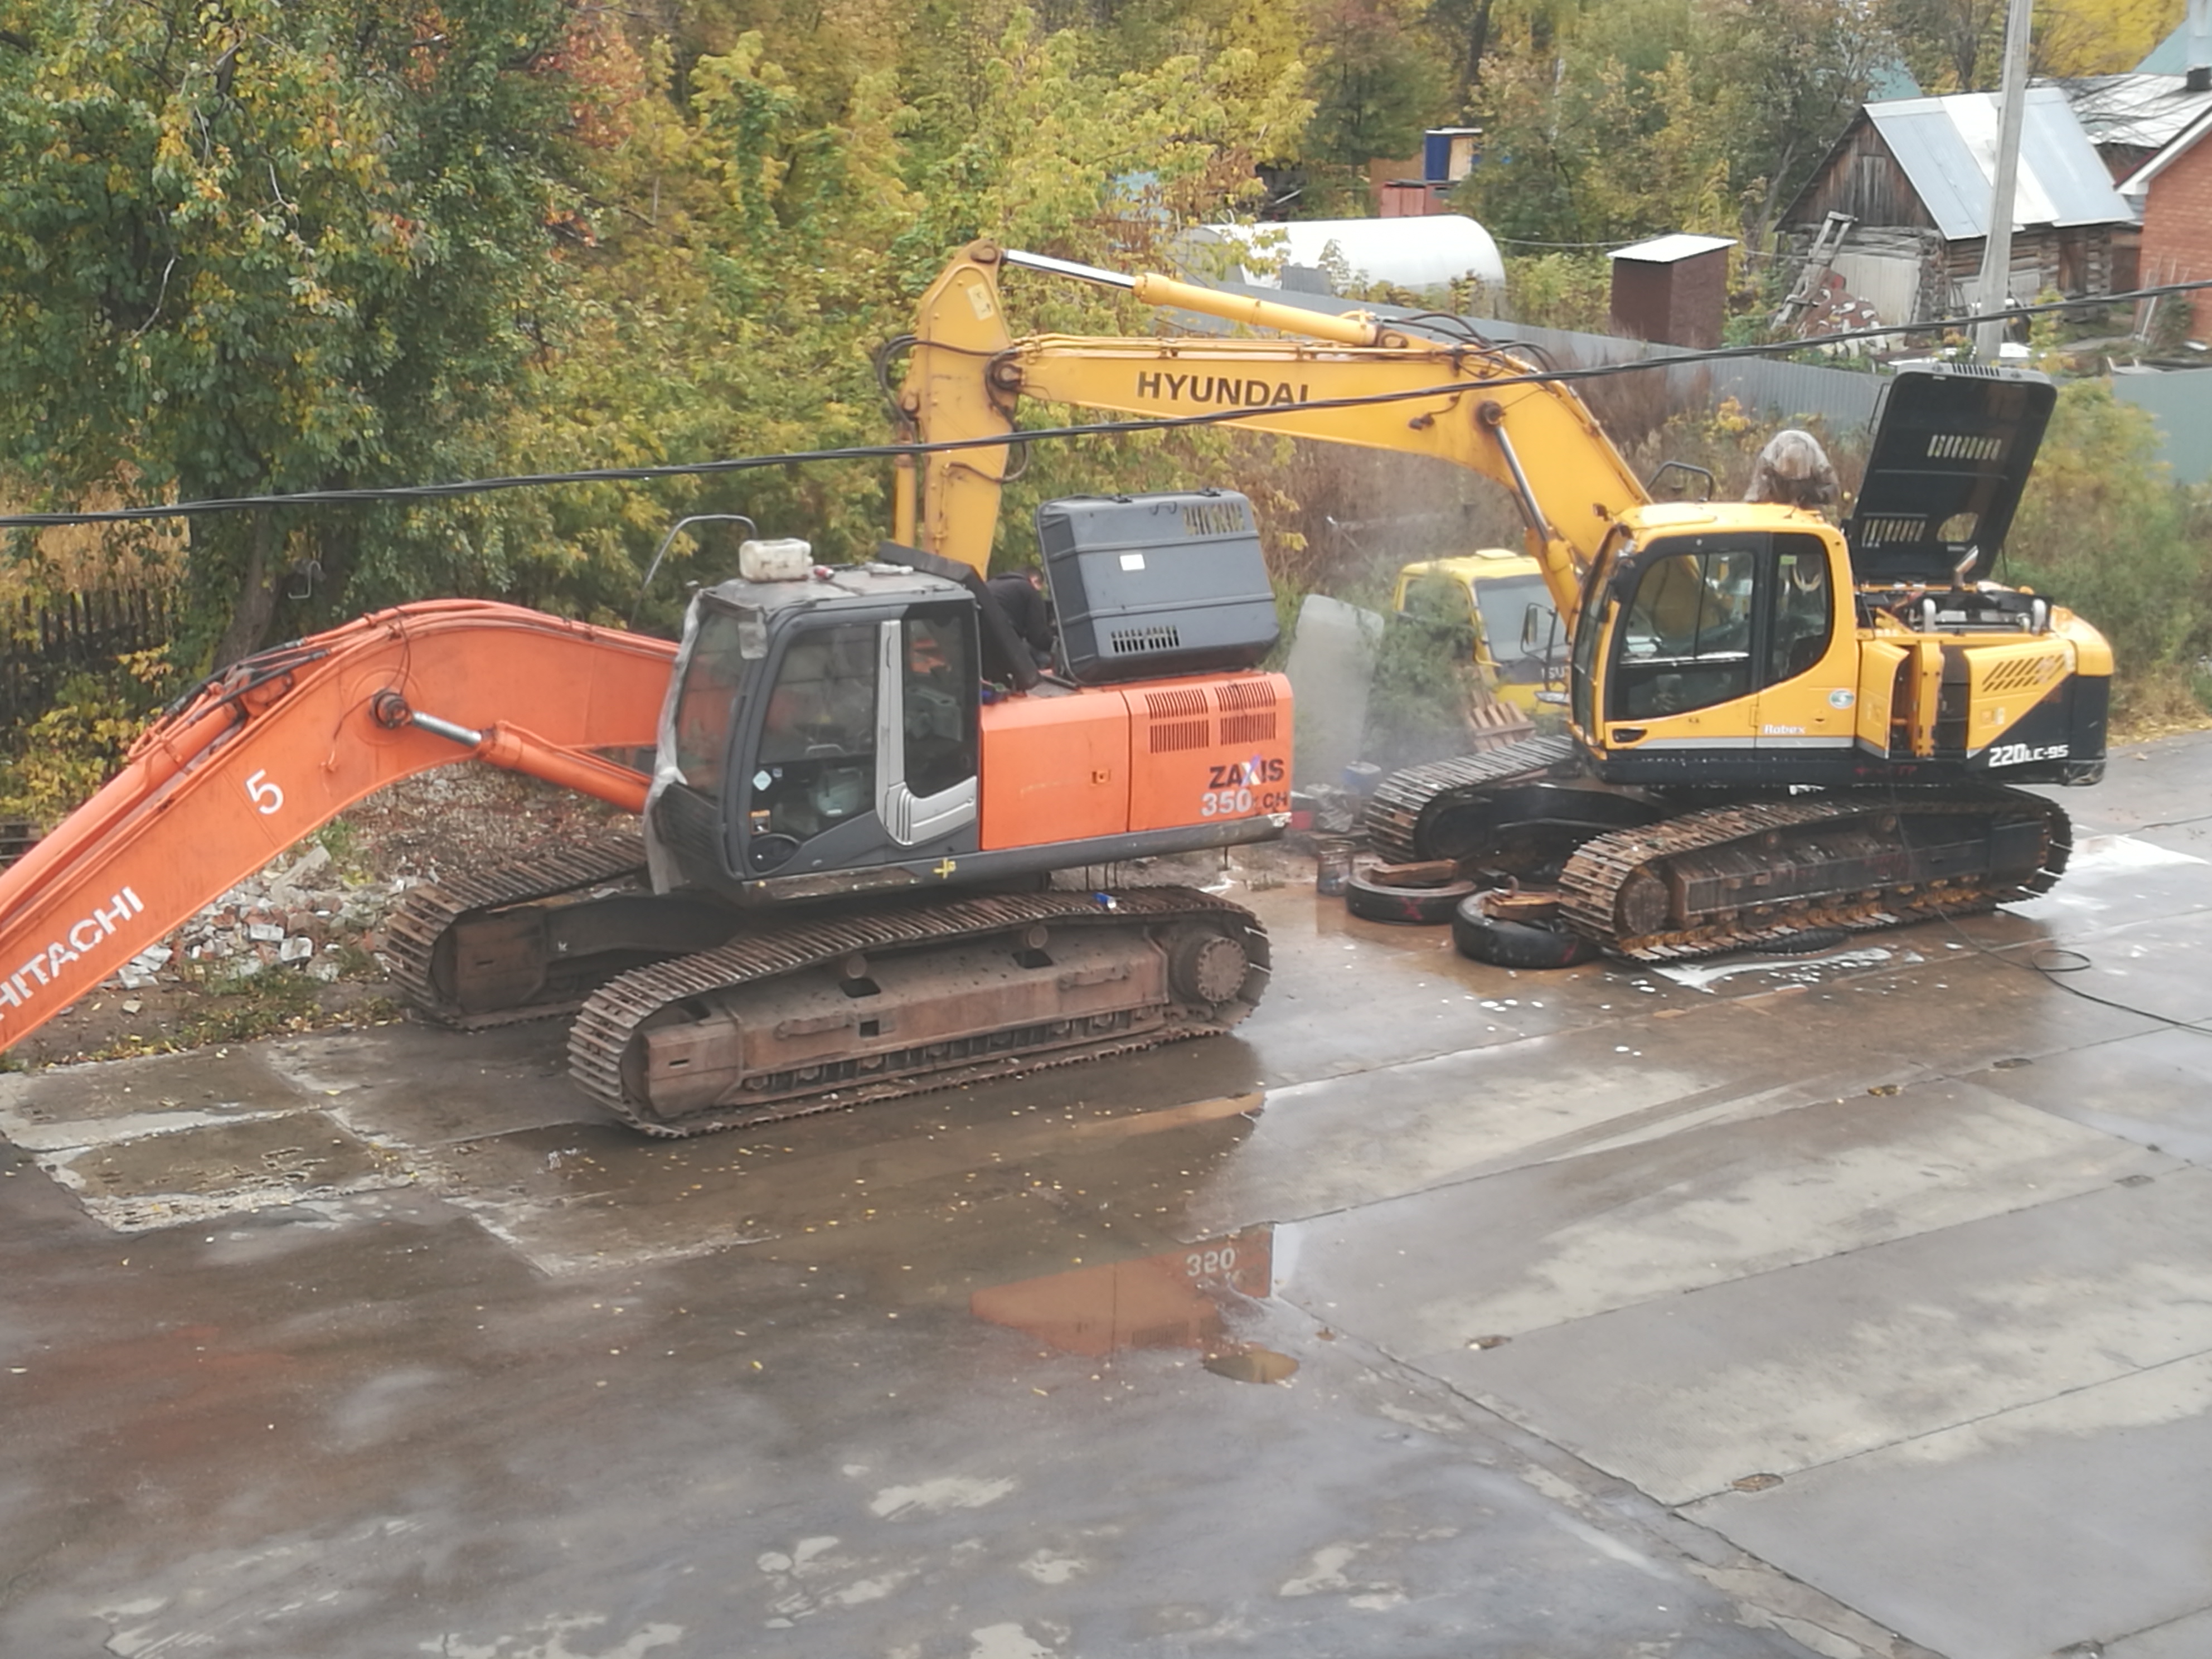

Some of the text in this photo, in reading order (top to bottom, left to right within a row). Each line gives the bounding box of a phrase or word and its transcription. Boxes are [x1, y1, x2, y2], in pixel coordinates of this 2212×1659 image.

[1137, 371, 1309, 406] HYUNDAI
[245, 769, 284, 814] 5
[1209, 754, 1286, 789] ZAXIS
[0, 886, 144, 1021] HITACHI
